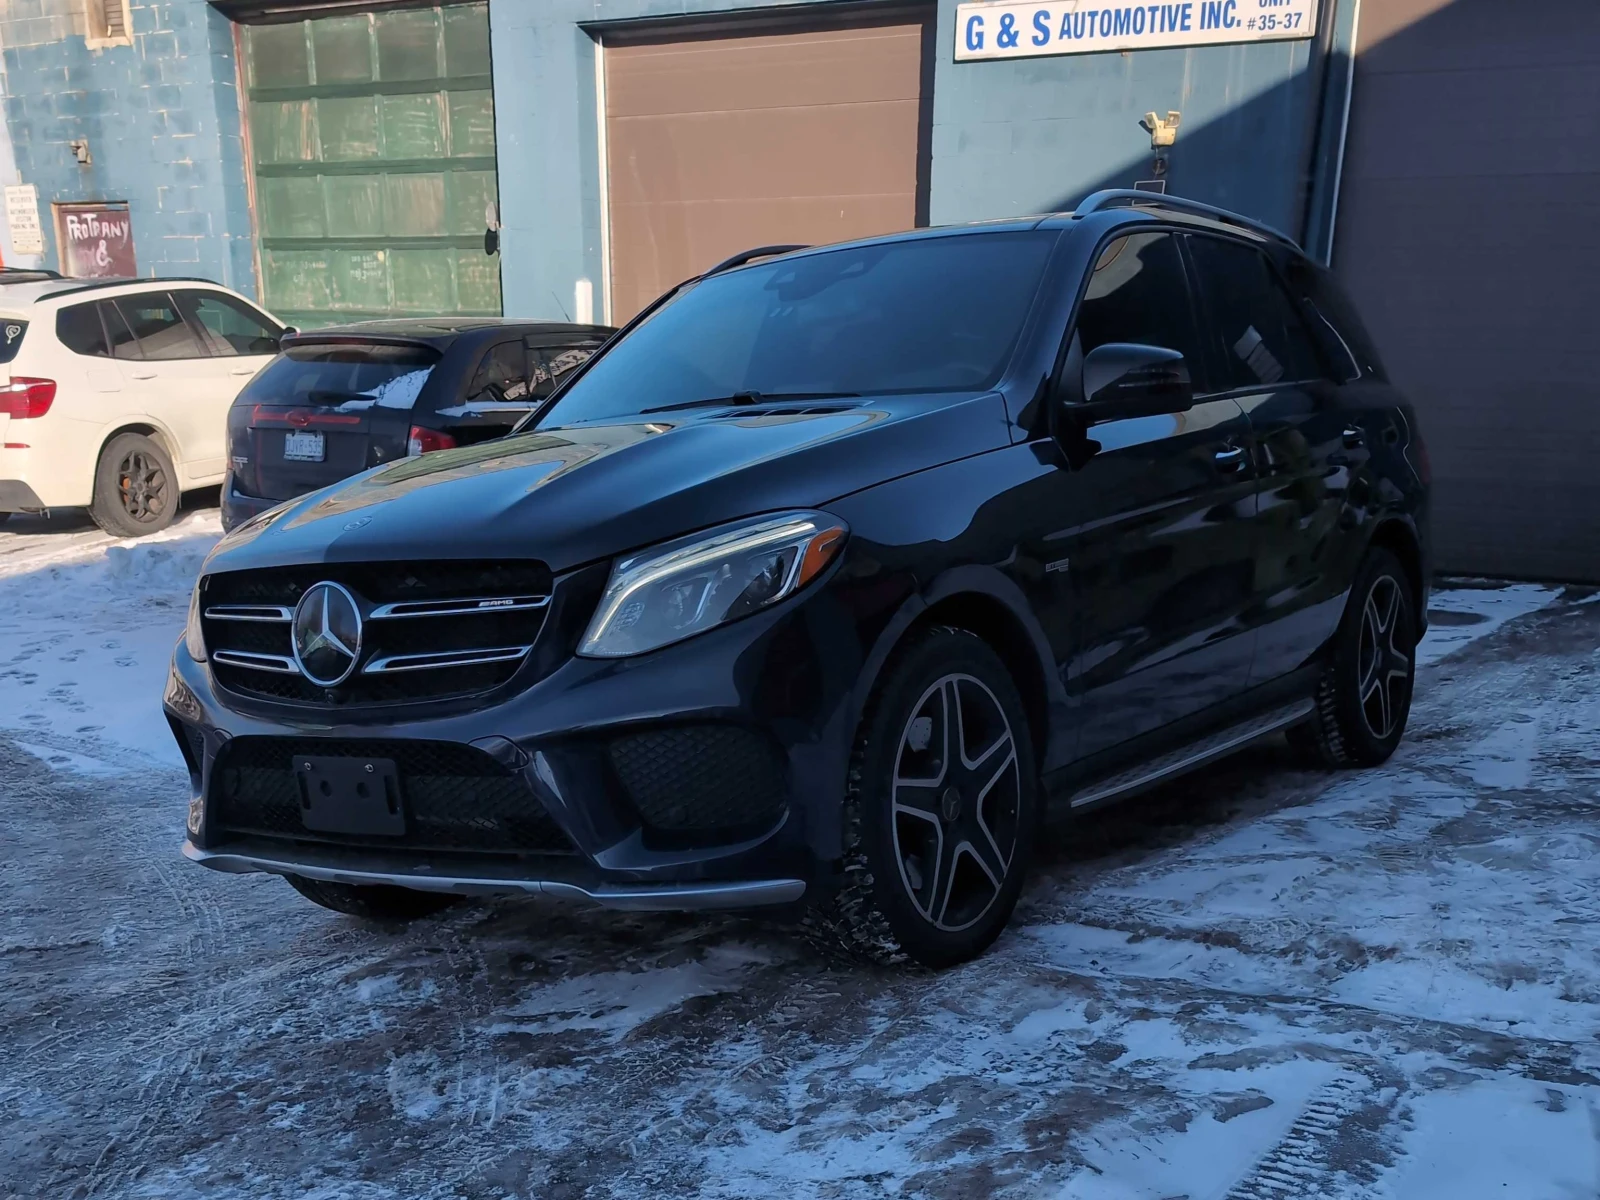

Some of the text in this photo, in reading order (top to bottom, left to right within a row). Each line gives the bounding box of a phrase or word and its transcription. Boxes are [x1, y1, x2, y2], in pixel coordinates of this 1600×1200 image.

[966, 0, 1242, 51] G & S AUTOMOTIVE INC.
[1246, 12, 1303, 31] #35-37
